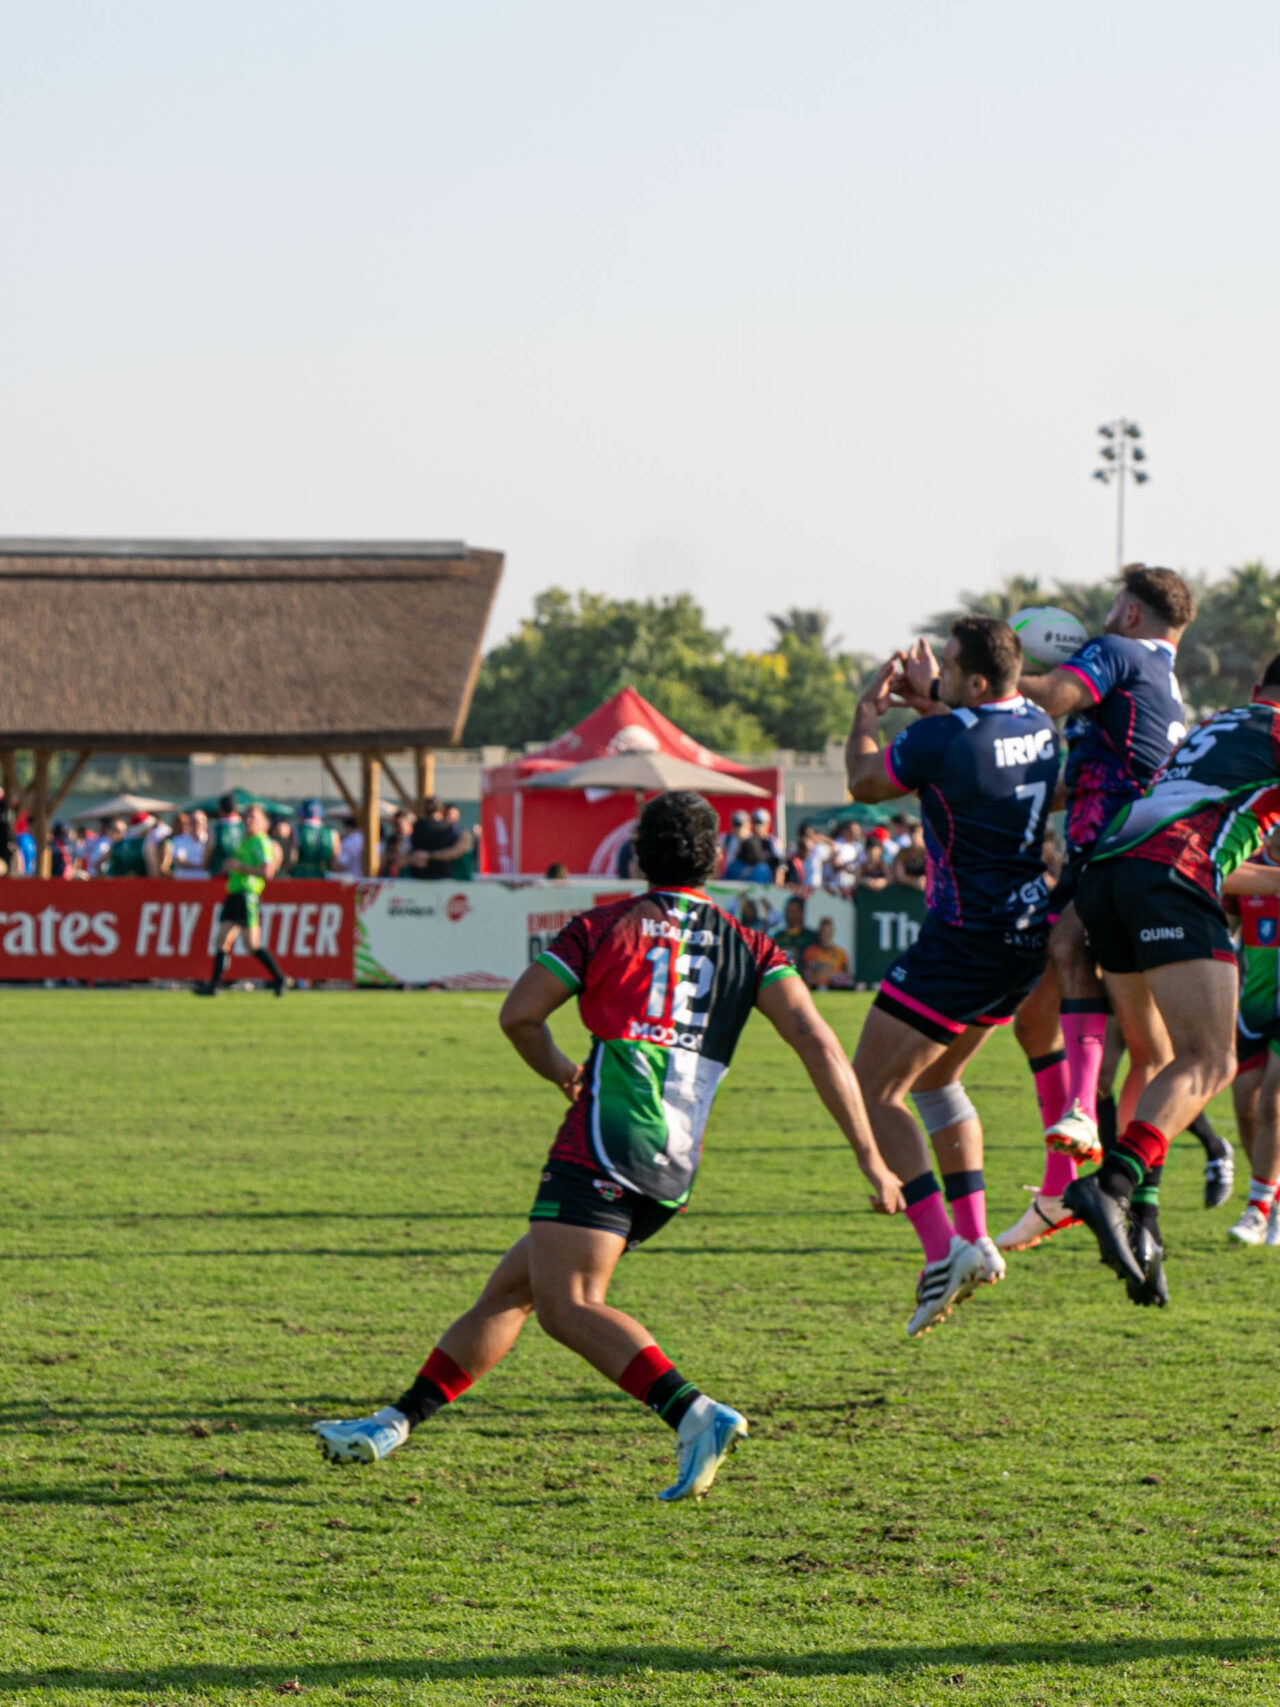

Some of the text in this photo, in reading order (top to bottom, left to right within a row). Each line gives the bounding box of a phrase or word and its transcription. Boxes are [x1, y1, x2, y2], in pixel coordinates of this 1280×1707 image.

[1015, 781, 1047, 853] 7
[0, 903, 343, 957] ates FLY TTER
[1140, 926, 1184, 943] QUINS
[646, 946, 715, 1027] 12
